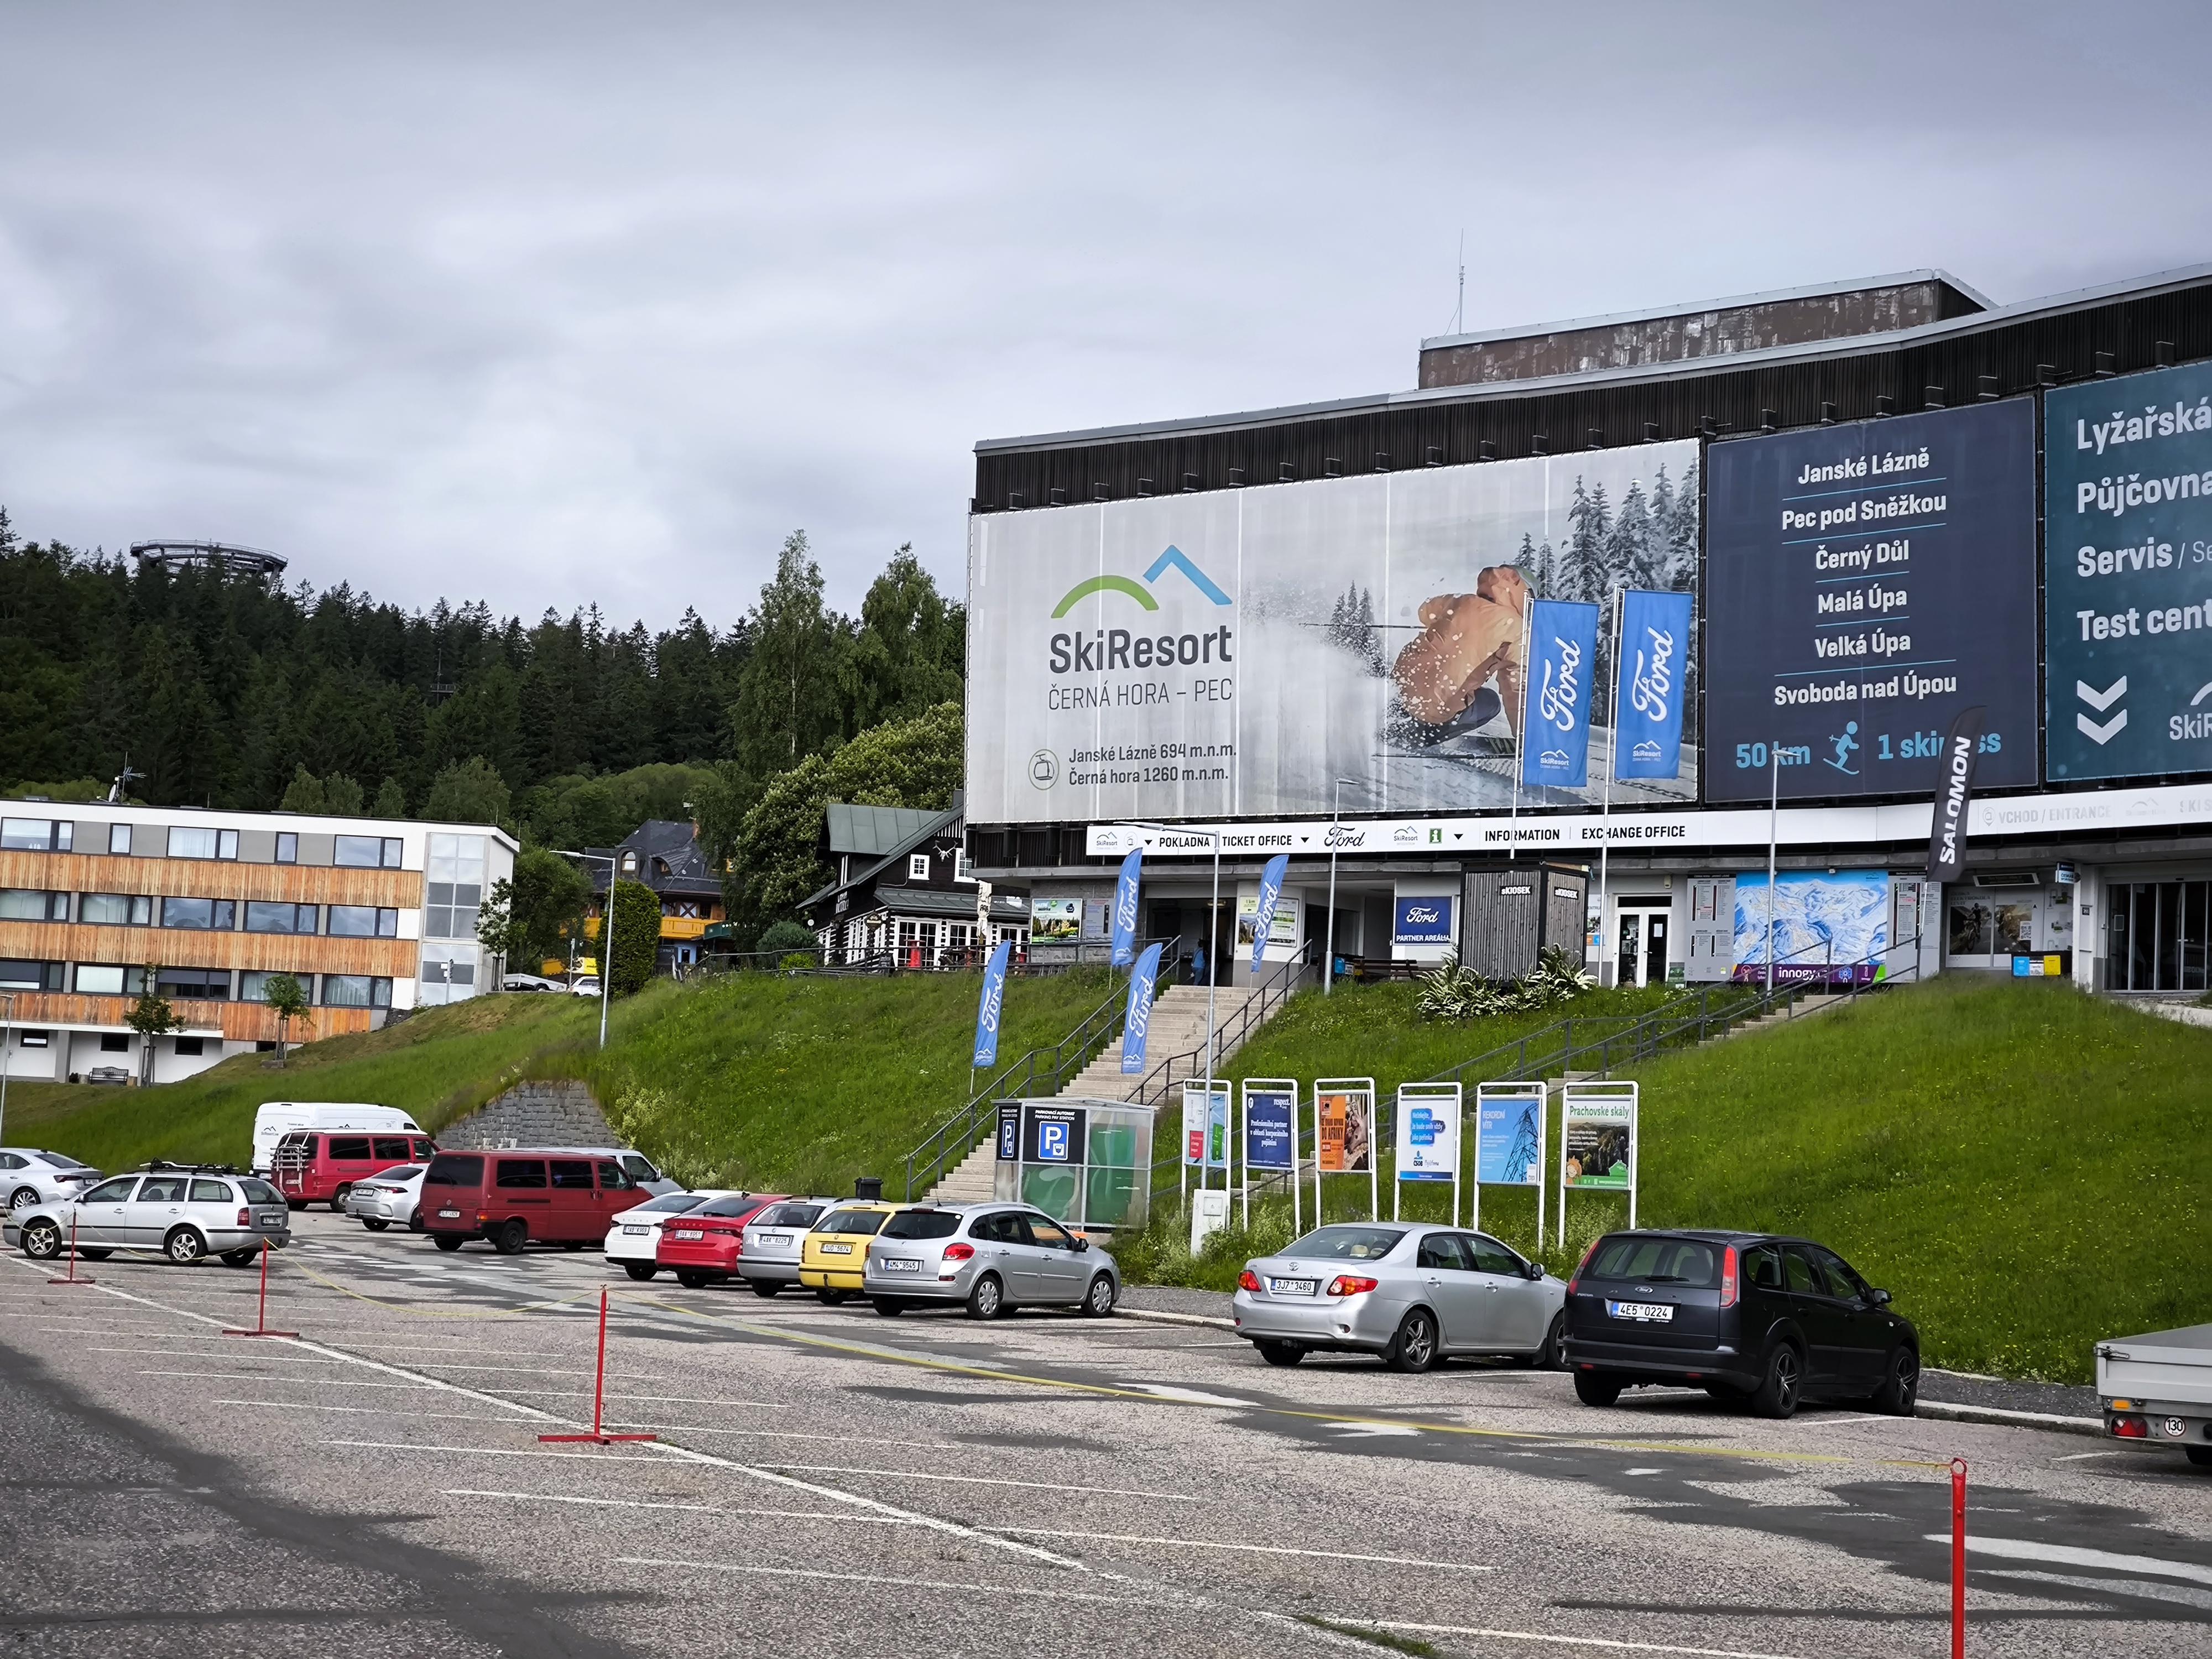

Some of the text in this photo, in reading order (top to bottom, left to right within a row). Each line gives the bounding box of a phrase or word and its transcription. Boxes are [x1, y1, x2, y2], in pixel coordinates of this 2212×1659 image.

[2078, 397, 2211, 455] Lyžařská
[1798, 447, 1929, 484] Janské Lázně
[2078, 471, 2212, 517] Půjčovna
[1782, 494, 1947, 531] Pec pod Sněžkou
[1815, 539, 1910, 571] Černý Důl
[2078, 537, 2172, 577] Servis
[1818, 583, 1907, 613] Malá Úpa
[2077, 608, 2140, 641] Test
[1049, 625, 1233, 674] SkiResort
[1814, 627, 1911, 658] Velká Úpa
[1632, 626, 1674, 722] Ford
[1048, 681, 1110, 710] ČERNÁ
[1118, 682, 1170, 706] HORA
[1195, 679, 1232, 702] PEC
[1540, 637, 1581, 732] Ford
[1775, 670, 1957, 706] Svoboda nad Úpou
[1069, 743, 1237, 763] Janské Lázně 694 m.n.m.
[1736, 731, 2001, 768] 50 km 1 skiss
[1540, 757, 1569, 766] SkiResort
[1069, 766, 1228, 785] Černá hora 1260 m.n.m.
[1939, 736, 1971, 864] SALOMON
[1999, 810, 2038, 823] VCHOD
[2049, 805, 2111, 821] ENTRANCE
[1160, 835, 1292, 847] POKLADNA TICKET OFFICE
[1324, 827, 1365, 847] Ford
[1485, 829, 1560, 841] INFORMATION
[1582, 826, 1686, 839] EXCHANGE OFFICE
[1501, 886, 1530, 895] sKIOSEK
[1555, 888, 1577, 899] sKIOSEK
[1406, 907, 1438, 923] Ford
[1129, 975, 1154, 1038] Ford
[1483, 1109, 1506, 1119] REKORDNÍ
[1570, 1105, 1629, 1119] Prachovské skály
[1482, 1120, 1493, 1129] VÍTR
[889, 1260, 916, 1270] 4M4 9545
[1277, 1281, 1312, 1291] 3J7 3460
[1620, 1305, 1668, 1318] 4E5 0224
[2167, 1419, 2184, 1432] 130
